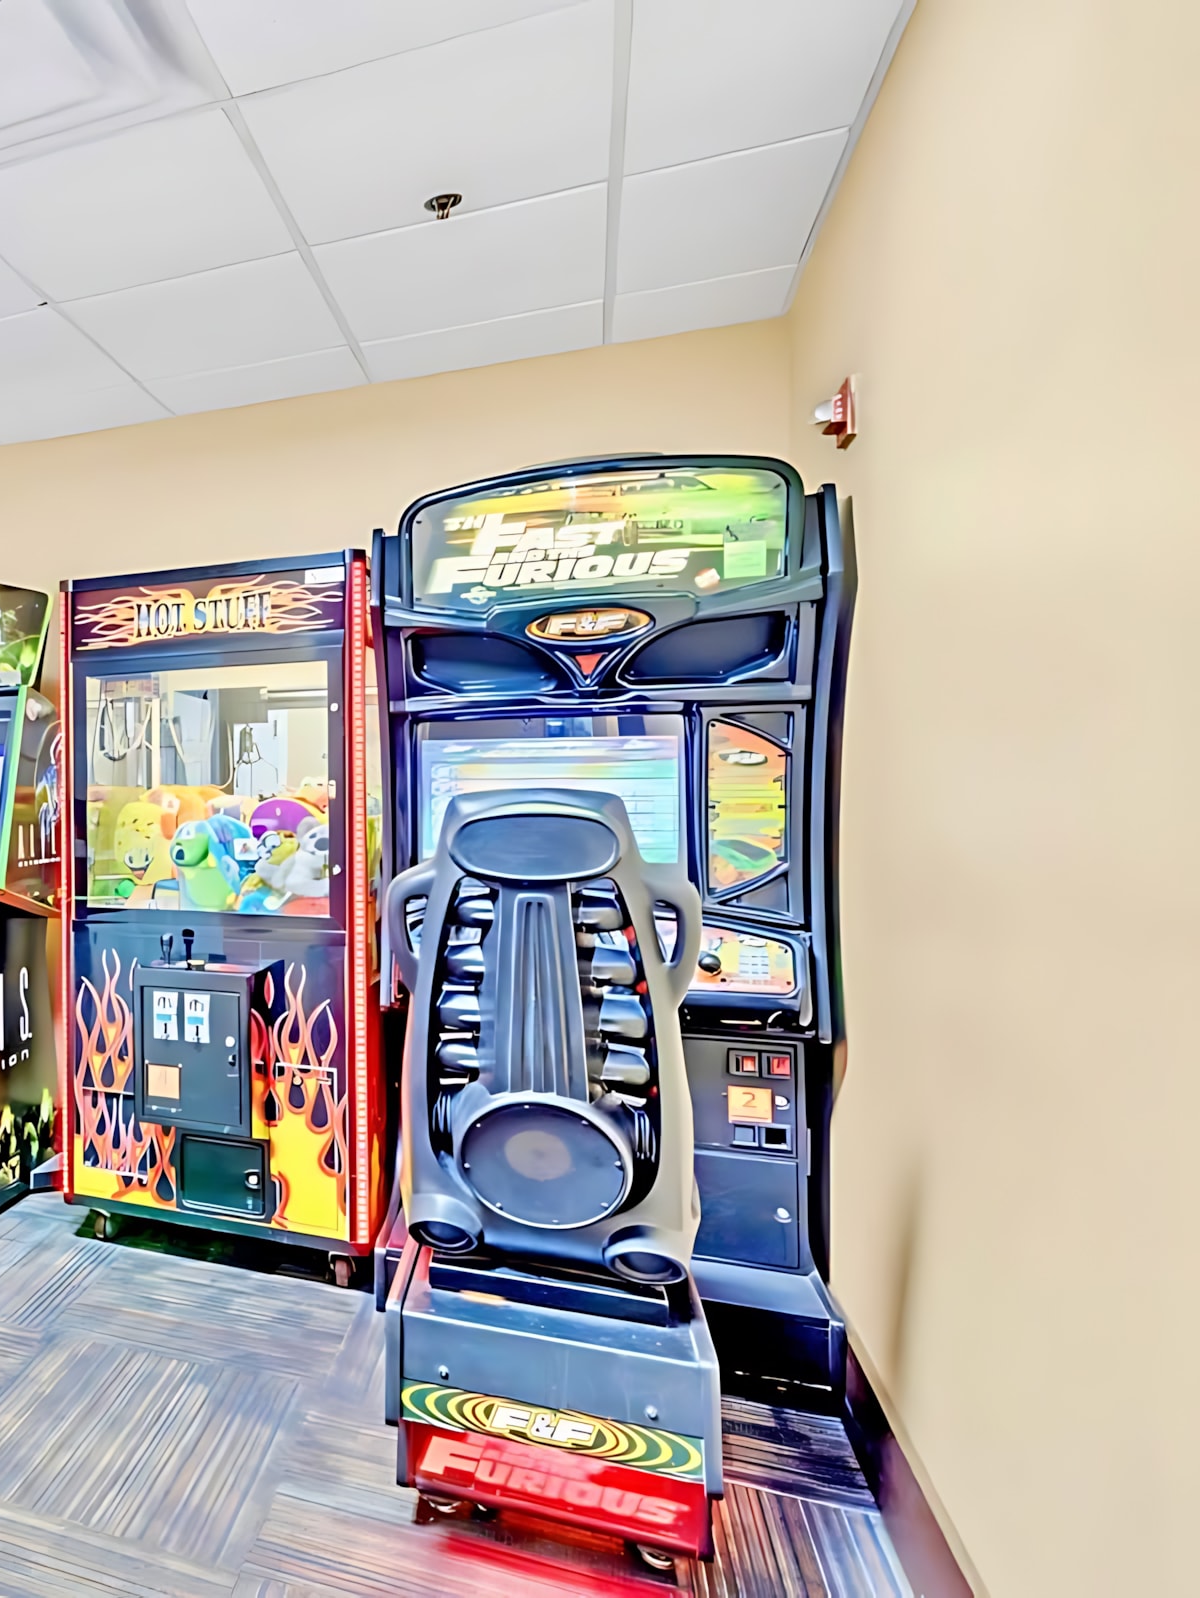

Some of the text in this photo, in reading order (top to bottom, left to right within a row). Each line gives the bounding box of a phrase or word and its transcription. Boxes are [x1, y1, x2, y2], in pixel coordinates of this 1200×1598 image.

[469, 513, 627, 557] FAST
[424, 549, 691, 595] FURIOUS
[135, 590, 272, 639] HOT STUFF
[741, 1091, 758, 1109] 2
[492, 1404, 597, 1441] F&F
[420, 1436, 691, 1526] FURIOUS
